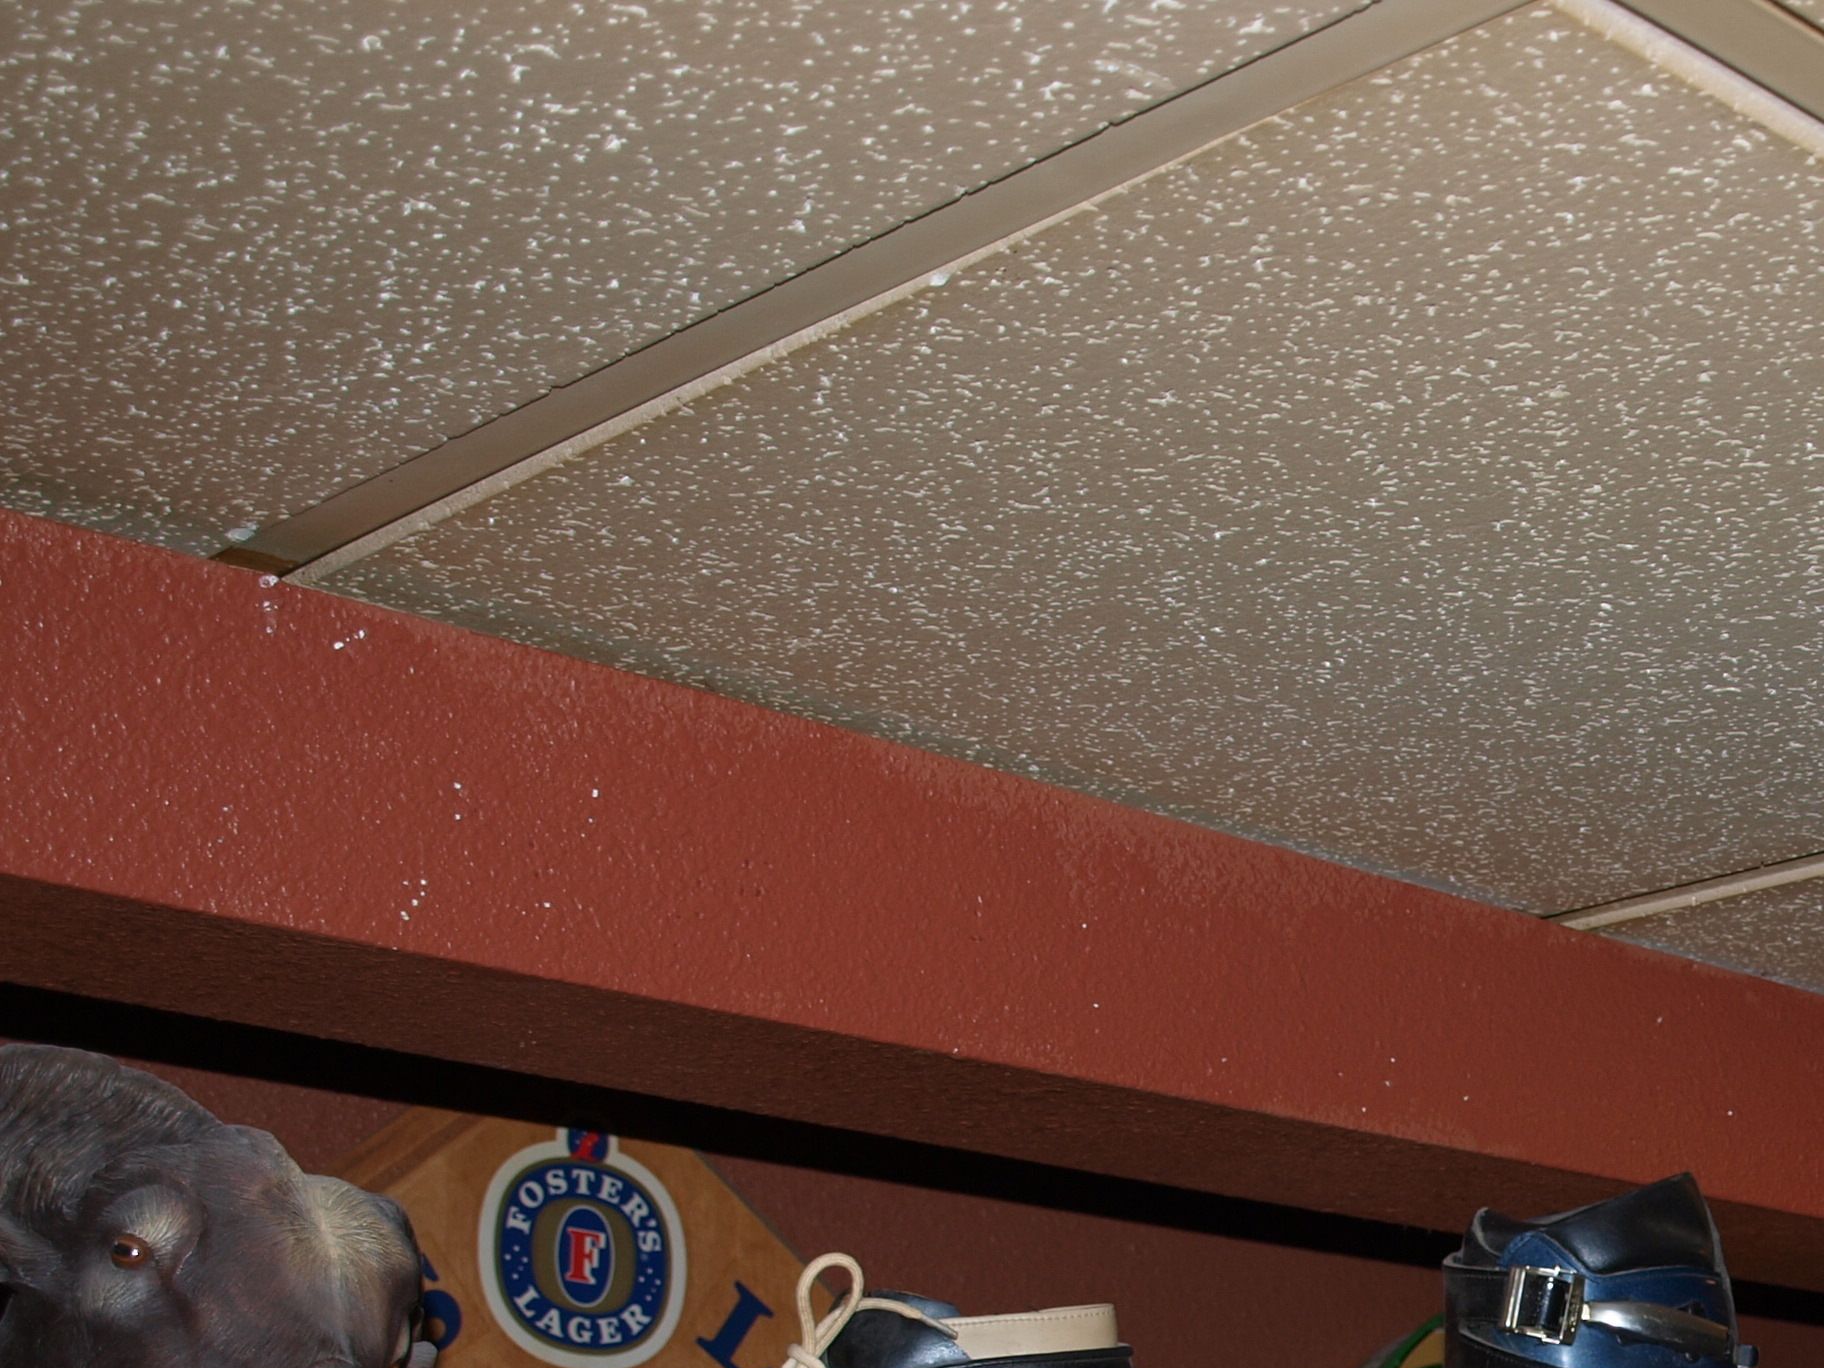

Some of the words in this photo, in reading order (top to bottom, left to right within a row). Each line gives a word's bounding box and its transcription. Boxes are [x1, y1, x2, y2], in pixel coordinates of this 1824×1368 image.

[506, 1168, 662, 1252] FOSTER'S
[565, 1226, 607, 1285] F
[513, 1284, 652, 1345] LAGER
